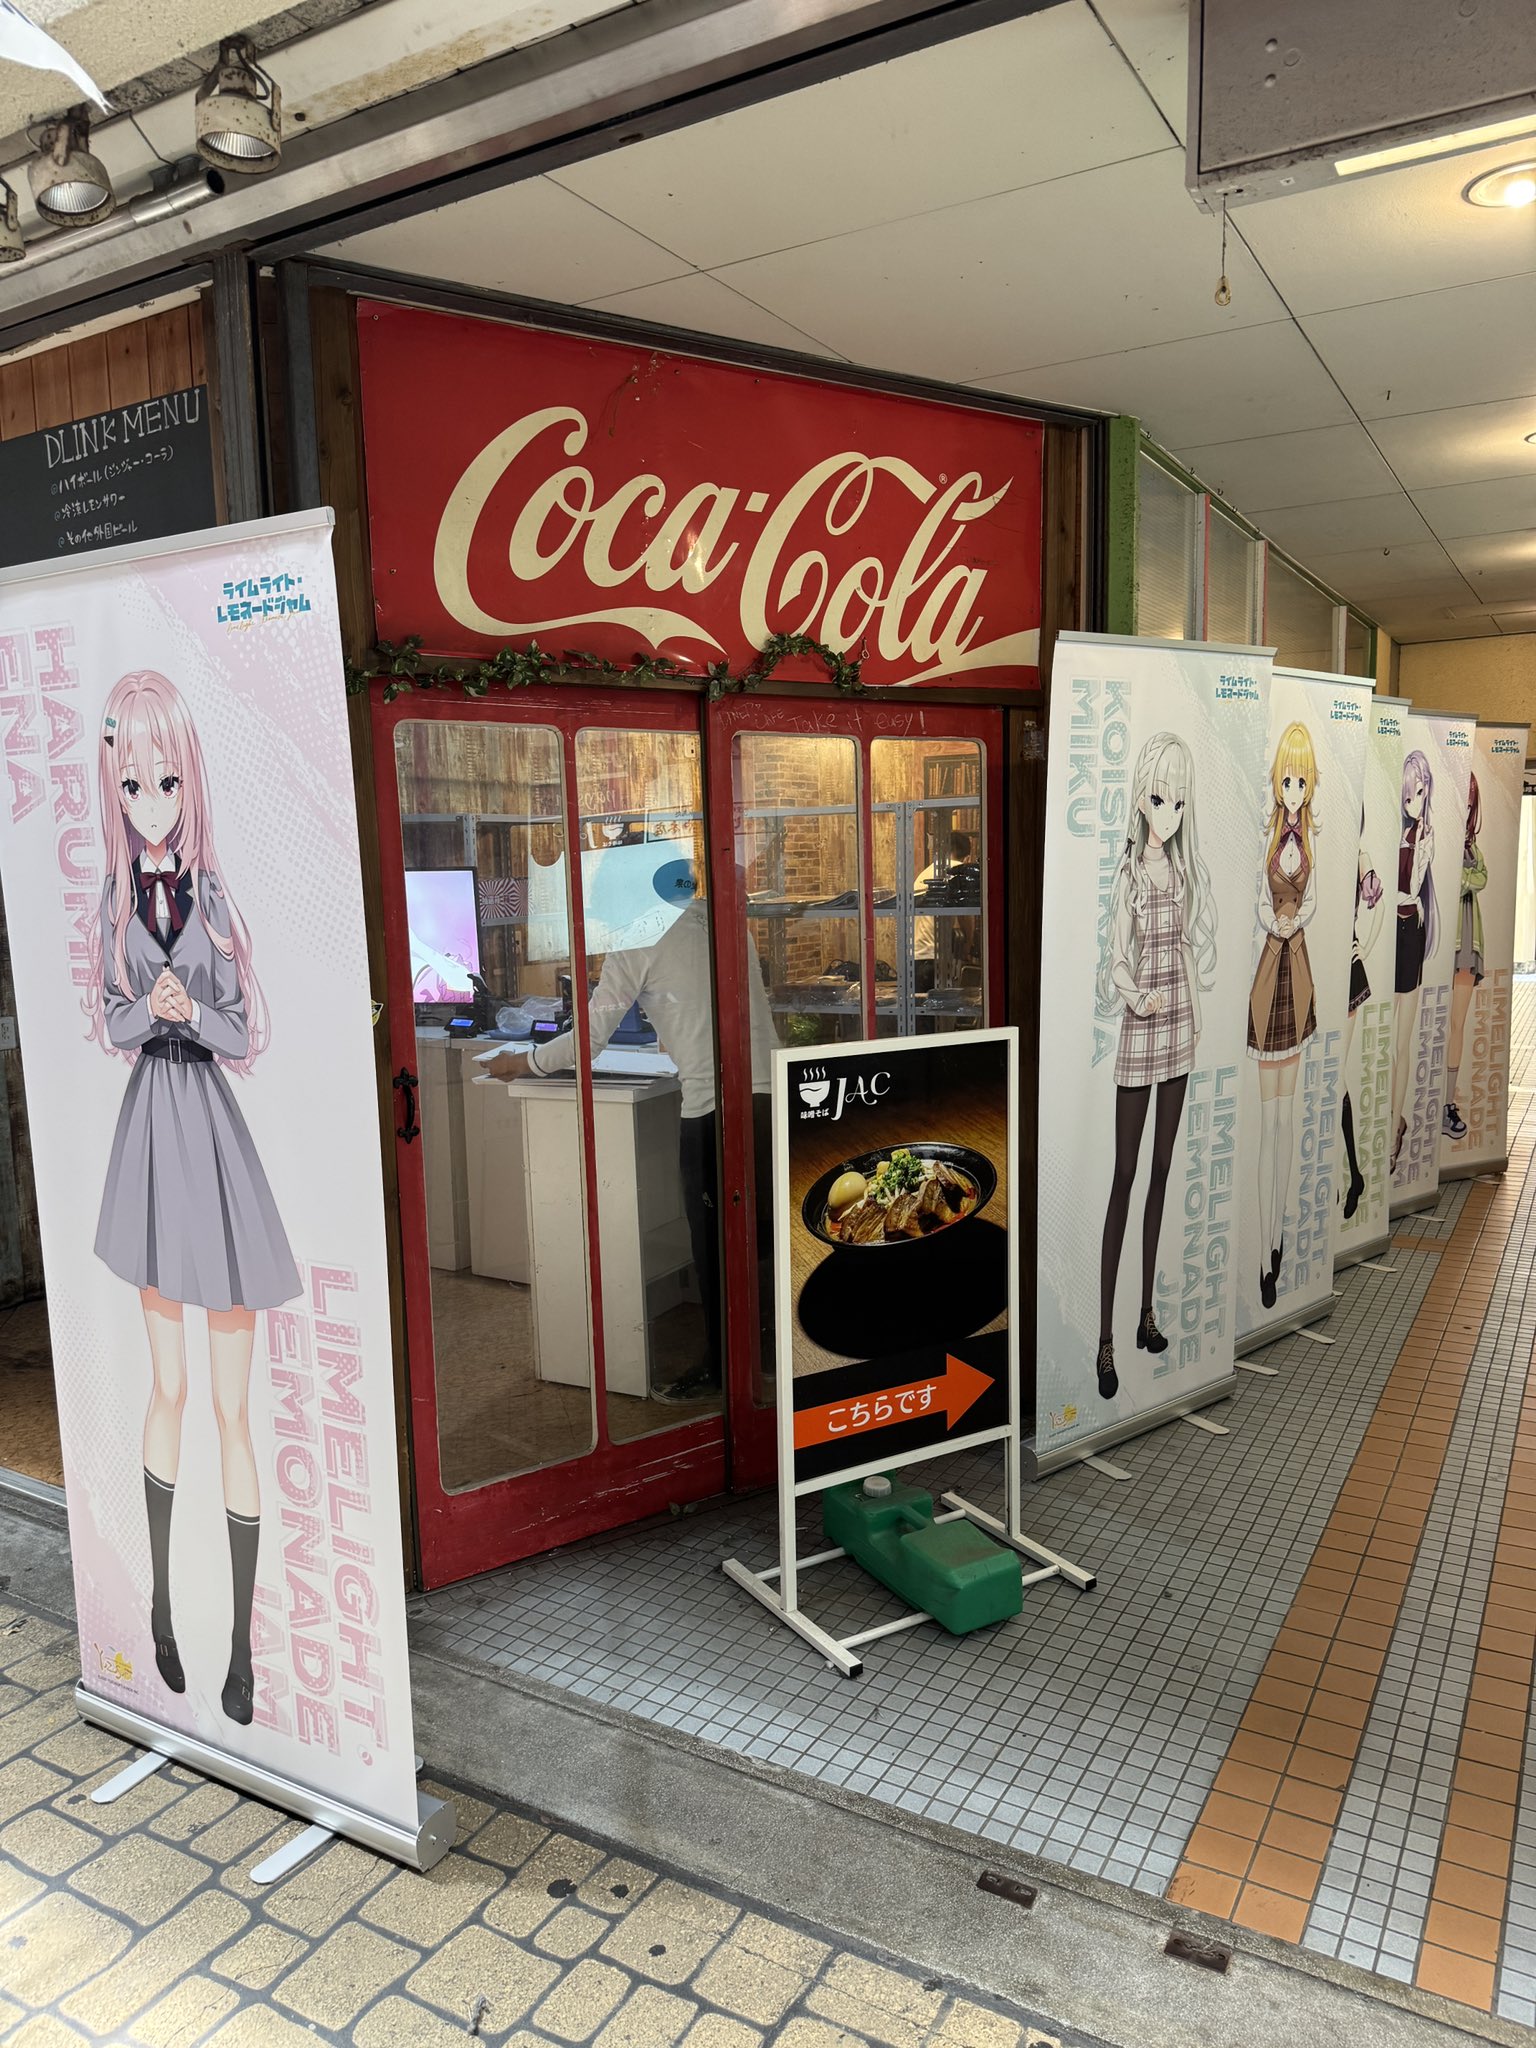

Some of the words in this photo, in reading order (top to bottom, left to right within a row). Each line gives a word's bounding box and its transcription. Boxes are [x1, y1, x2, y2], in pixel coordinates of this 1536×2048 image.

[44, 415, 117, 469] DLINK
[121, 387, 201, 444] MENU
[217, 593, 311, 624] レモネードジャム
[434, 406, 1039, 684] Coca-Cola
[0, 632, 47, 825] ENA
[786, 711, 837, 733] Take
[846, 709, 863, 732] it
[1066, 678, 1101, 838] MIKU
[1215, 687, 1259, 700] レモネードジャム
[34, 626, 100, 987] HARUMI
[831, 1071, 891, 1121] JAC
[1312, 1030, 1341, 1265] LIMELIGHT
[1371, 1002, 1392, 1208] LIMELIGHT
[1407, 986, 1436, 1185] LEMONADE
[1422, 985, 1449, 1168] LIMELIGHT
[1486, 968, 1509, 1137] LIMELIGHT
[1179, 1070, 1211, 1370] LEMONADE
[1204, 1065, 1238, 1339] LIMELIGHT
[827, 1384, 937, 1433] こちらです
[266, 1263, 341, 1757] EMONADE
[311, 1265, 389, 1752] LIMELIGHT
